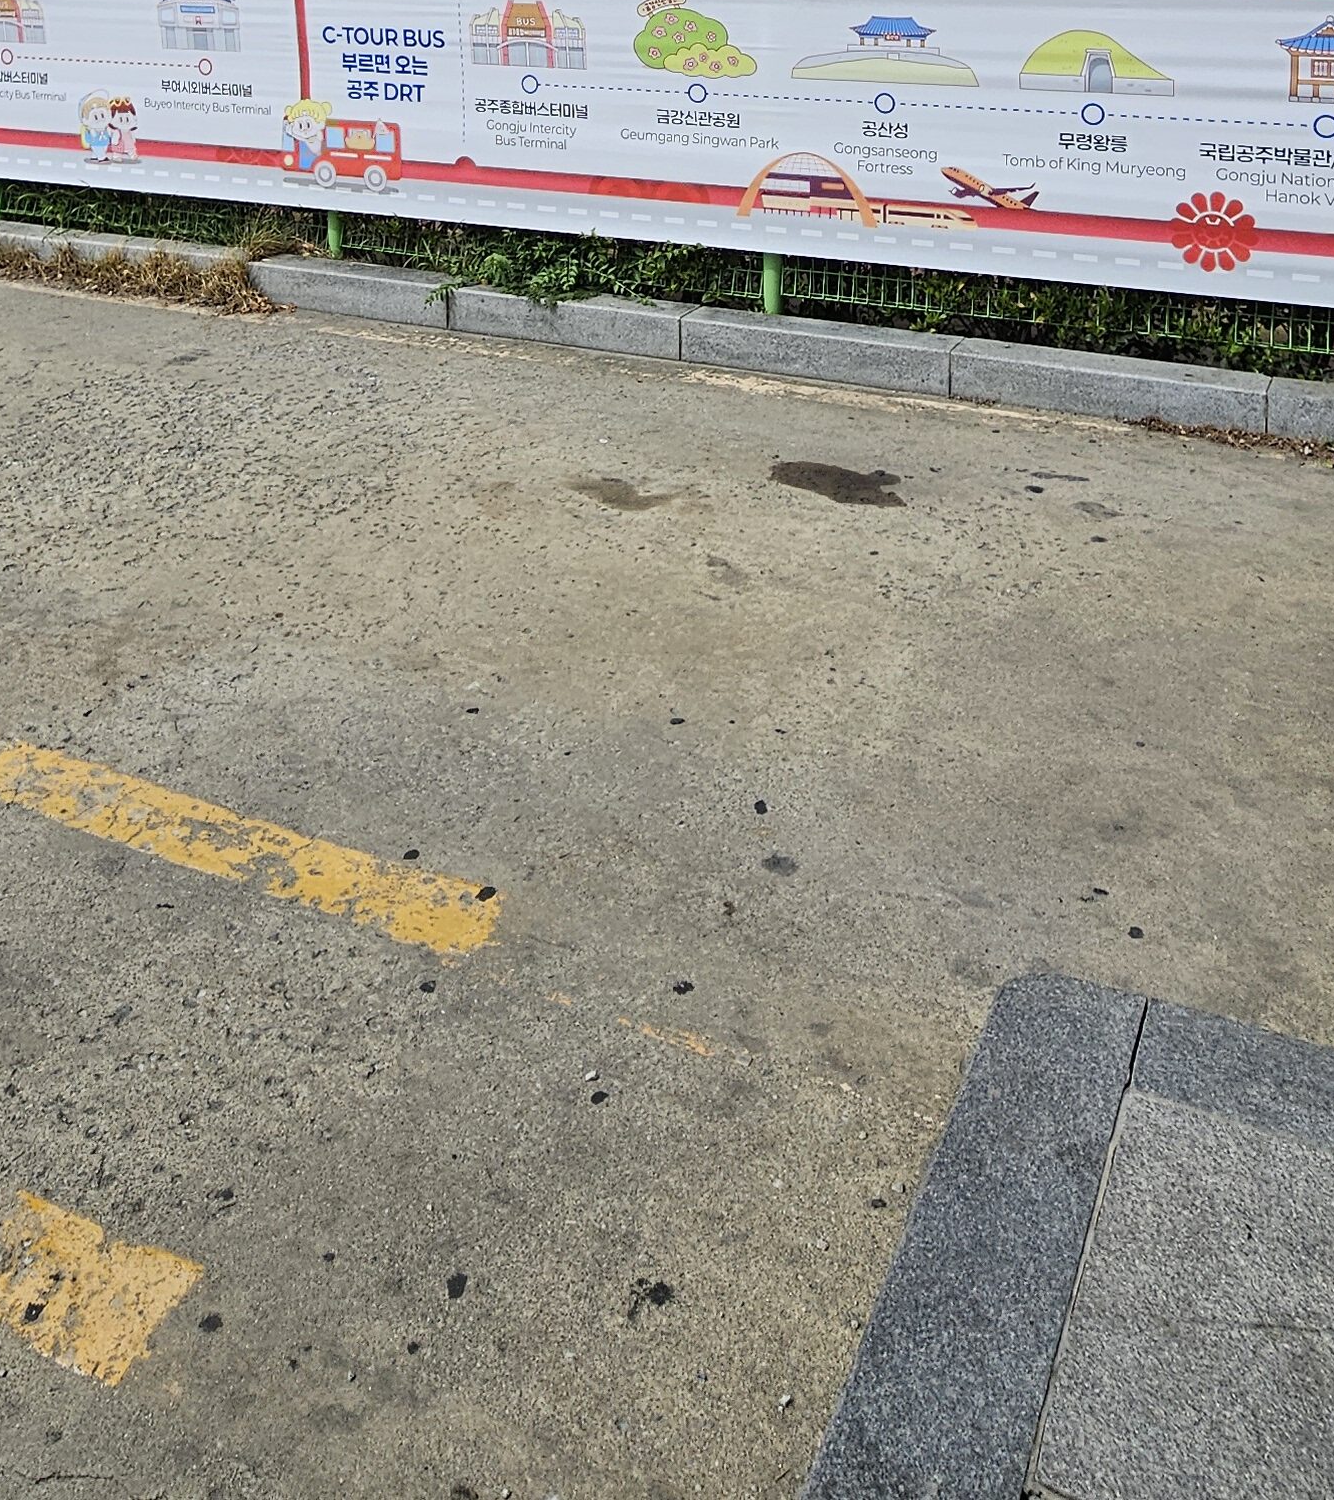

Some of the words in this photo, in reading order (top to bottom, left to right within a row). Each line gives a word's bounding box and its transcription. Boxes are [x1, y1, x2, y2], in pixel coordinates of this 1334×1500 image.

[516, 16, 536, 26] BUS
[322, 26, 399, 47] C-TOUR
[404, 29, 445, 48] BUS
[341, 52, 391, 74] 부르면
[395, 55, 428, 76] 오는
[15, 90, 31, 99] Bus
[32, 91, 67, 101] Terminal
[161, 79, 253, 98] 부여시외버스터미널
[347, 79, 380, 100] 공주
[384, 83, 425, 102] DRT
[144, 98, 172, 110] Buyeo
[173, 100, 211, 113] Intercity
[212, 103, 230, 112] Bus
[231, 103, 272, 115] Terminal
[474, 98, 589, 120] 공주종합버스터미널
[656, 108, 741, 128] 금강신관공원
[486, 119, 528, 134] Gongju
[529, 122, 577, 137] Intercity
[862, 121, 909, 139] 공산성
[495, 134, 517, 146] Bus
[518, 136, 567, 150] Terminal
[620, 128, 690, 146] Geumgang
[692, 132, 748, 148] Singwan
[749, 136, 780, 150] Park
[1058, 132, 1128, 153] 무령왕릉
[833, 142, 938, 163] Gongsanseong
[857, 160, 914, 175] Fortress
[1003, 153, 1046, 168] Tomb
[1049, 156, 1064, 169] of
[1067, 158, 1101, 176] King
[1106, 161, 1187, 181] Muryeong
[1215, 167, 1276, 186] Gongju
[1265, 189, 1322, 206] Hanok
